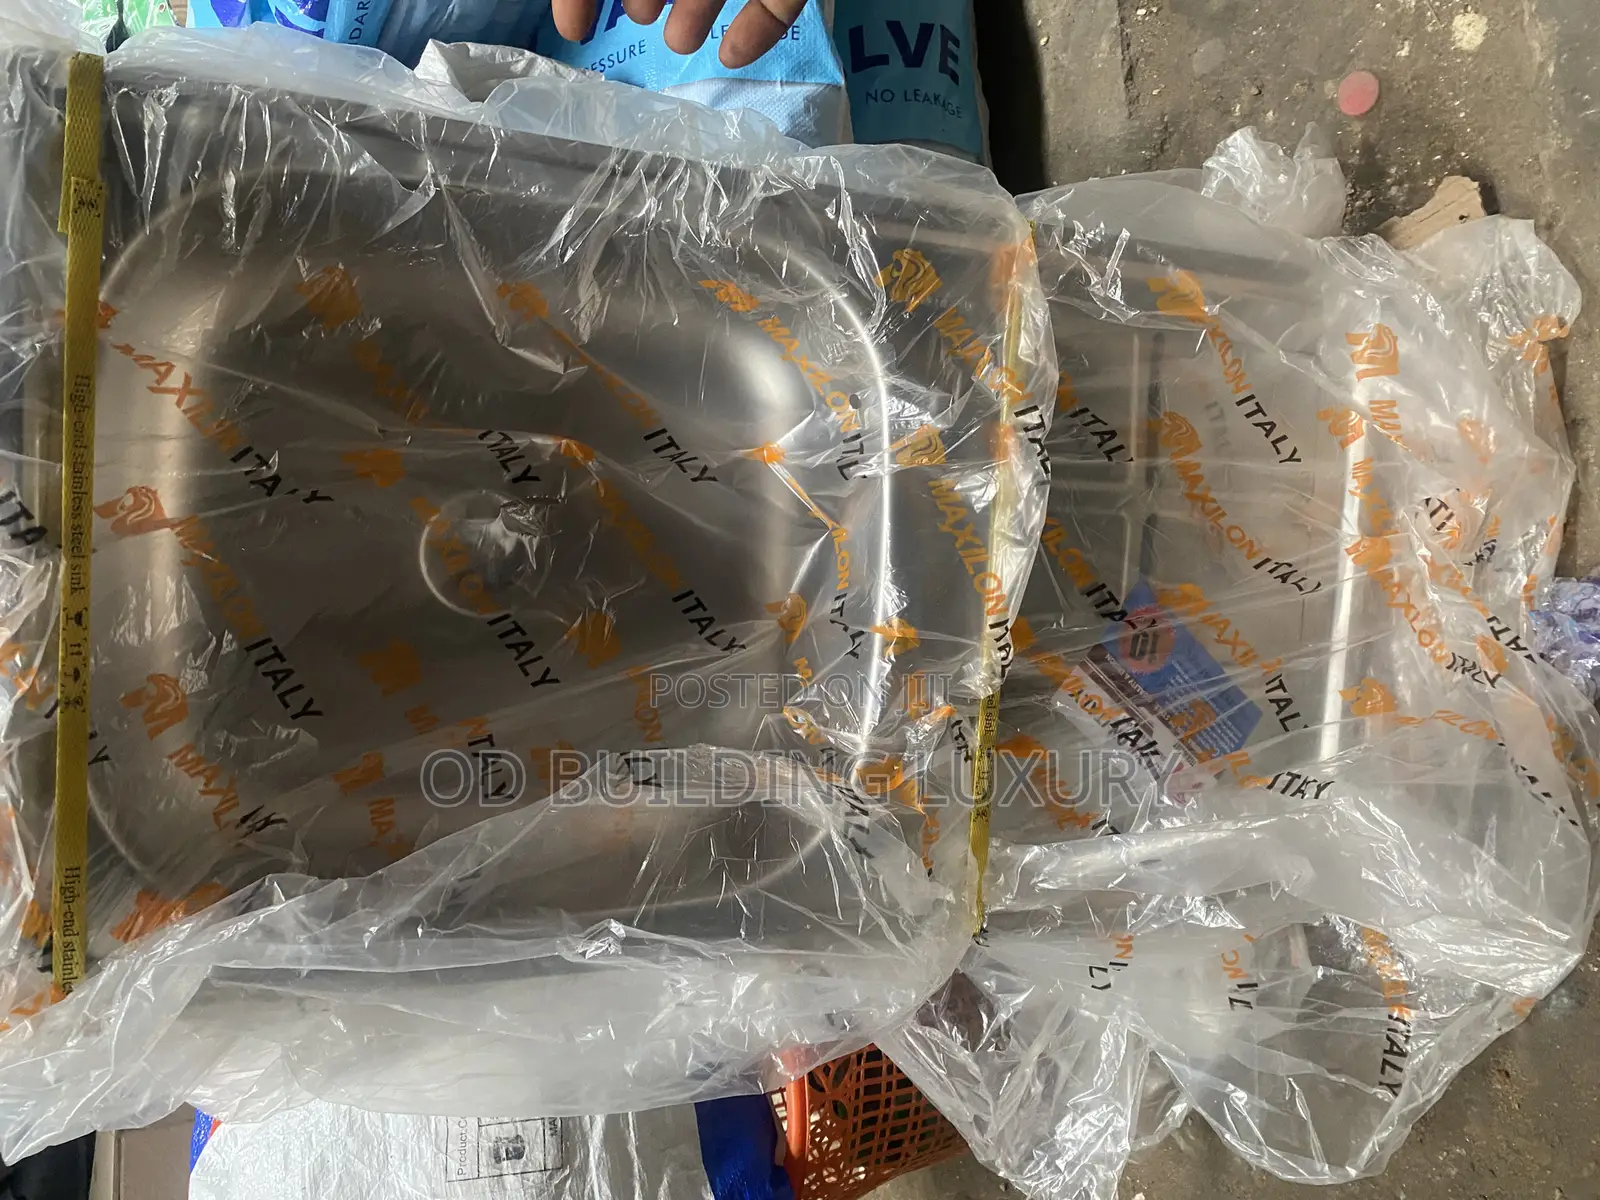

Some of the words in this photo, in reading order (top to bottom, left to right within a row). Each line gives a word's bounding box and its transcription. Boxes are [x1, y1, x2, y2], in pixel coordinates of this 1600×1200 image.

[585, 38, 647, 73] ESSURE
[848, 19, 960, 86] LVE
[865, 88, 895, 105] NO
[904, 89, 963, 119] LEAKAGE
[477, 429, 541, 484] ITALY
[643, 428, 719, 484] ITALY
[1068, 406, 1134, 463] ITAL
[1235, 393, 1303, 465] ITALY
[230, 446, 335, 505] ITAY
[928, 479, 1010, 617] MAXILON
[1173, 460, 1264, 562] MAXILON
[1253, 556, 1323, 596] ITALY
[69, 563, 86, 596] sink
[487, 613, 561, 689] ITALY
[671, 589, 748, 653] ITALY
[829, 592, 865, 660] ITLY
[243, 636, 325, 721] ITALY
[1264, 673, 1310, 732] ITAL
[60, 866, 81, 938] High-end
[457, 1132, 468, 1176] Product
